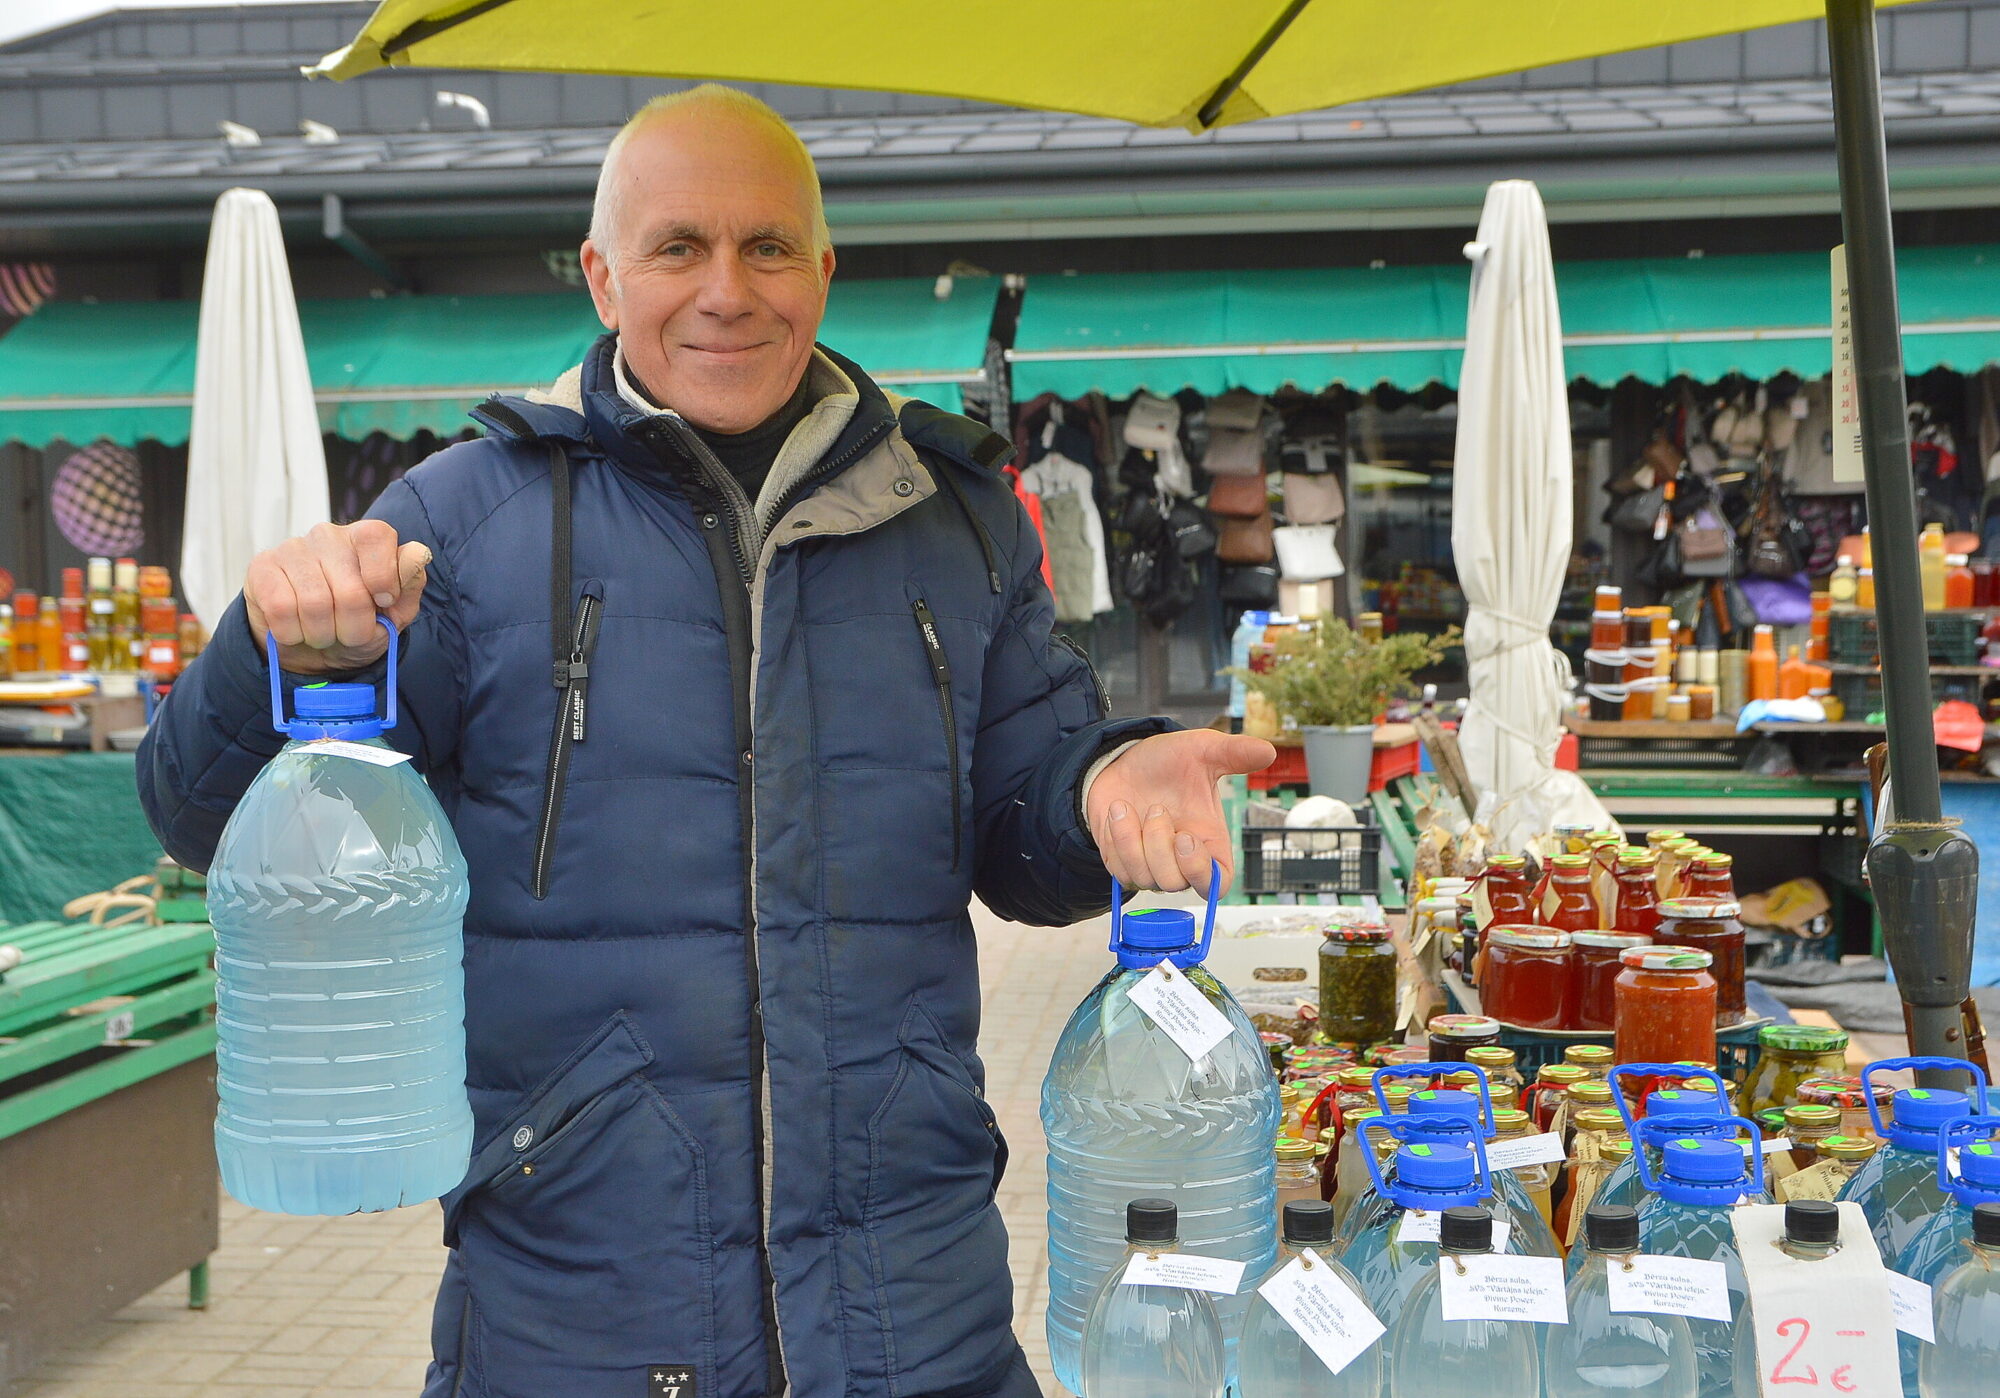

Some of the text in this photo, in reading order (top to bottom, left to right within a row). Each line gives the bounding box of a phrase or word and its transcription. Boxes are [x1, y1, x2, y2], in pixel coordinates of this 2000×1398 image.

[925, 622, 940, 650] CLASSIC
[573, 689, 581, 740] BEST CLASSIC
[1770, 1317, 1819, 1386] 2
[1831, 1364, 1858, 1393] €
